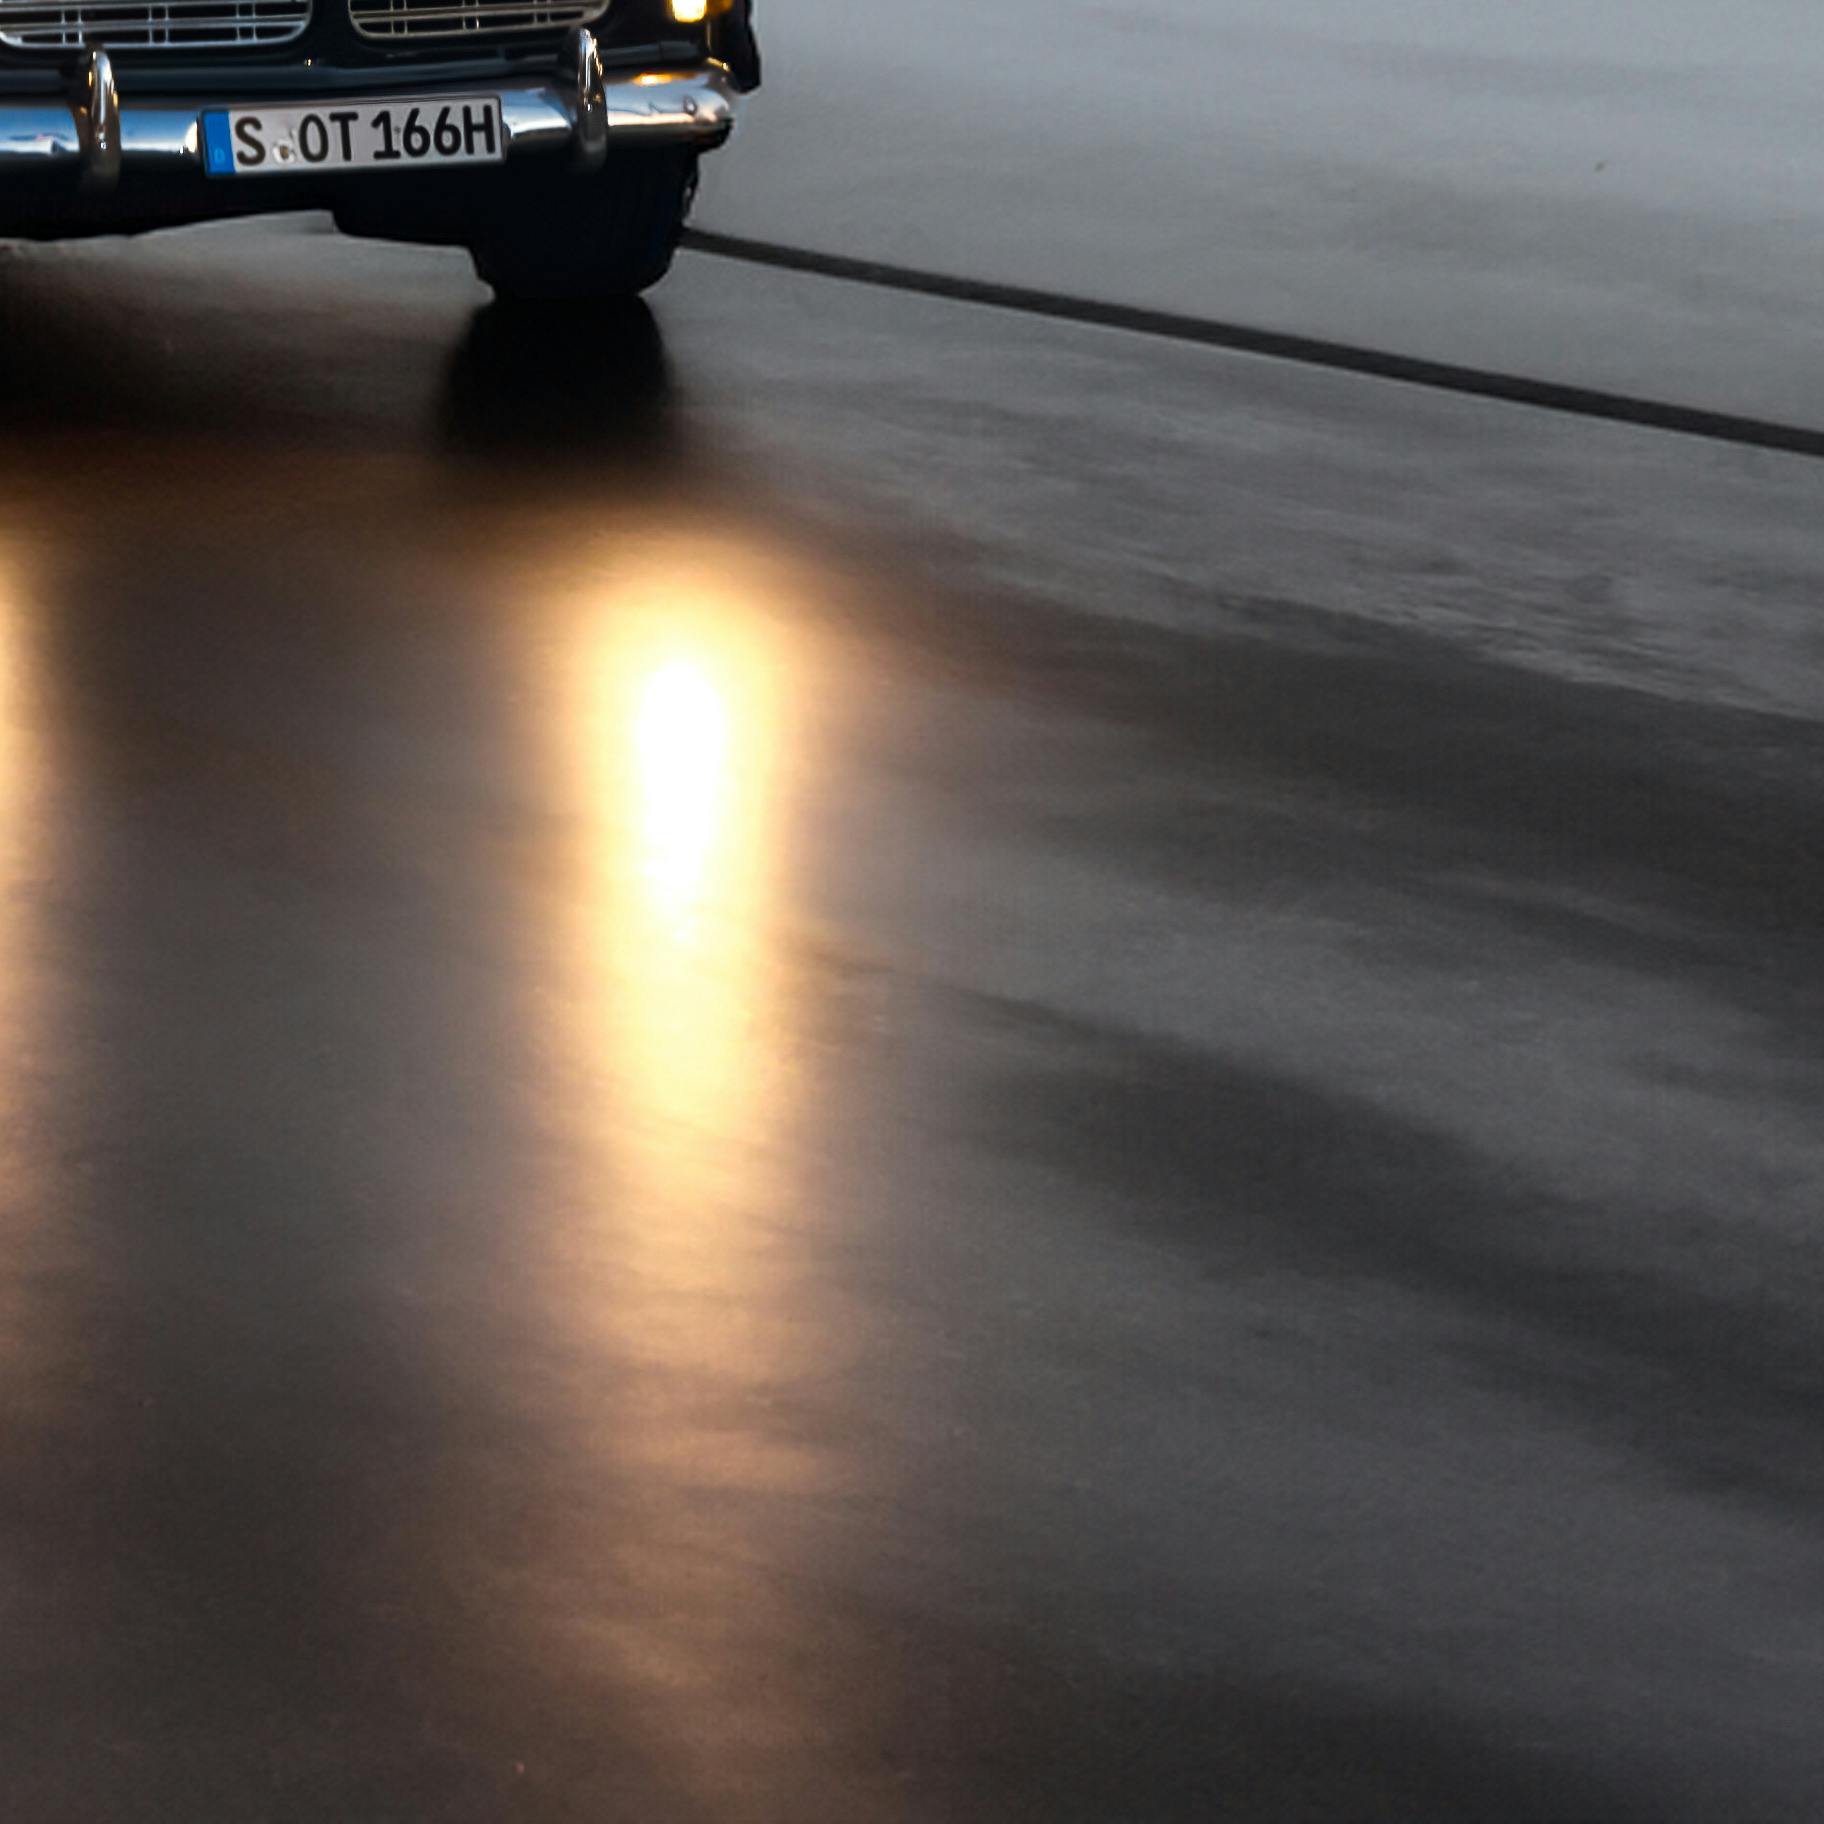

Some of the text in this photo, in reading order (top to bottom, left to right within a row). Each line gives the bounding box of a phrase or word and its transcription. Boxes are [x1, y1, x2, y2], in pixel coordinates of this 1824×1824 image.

[235, 103, 497, 166] S OT 166H
